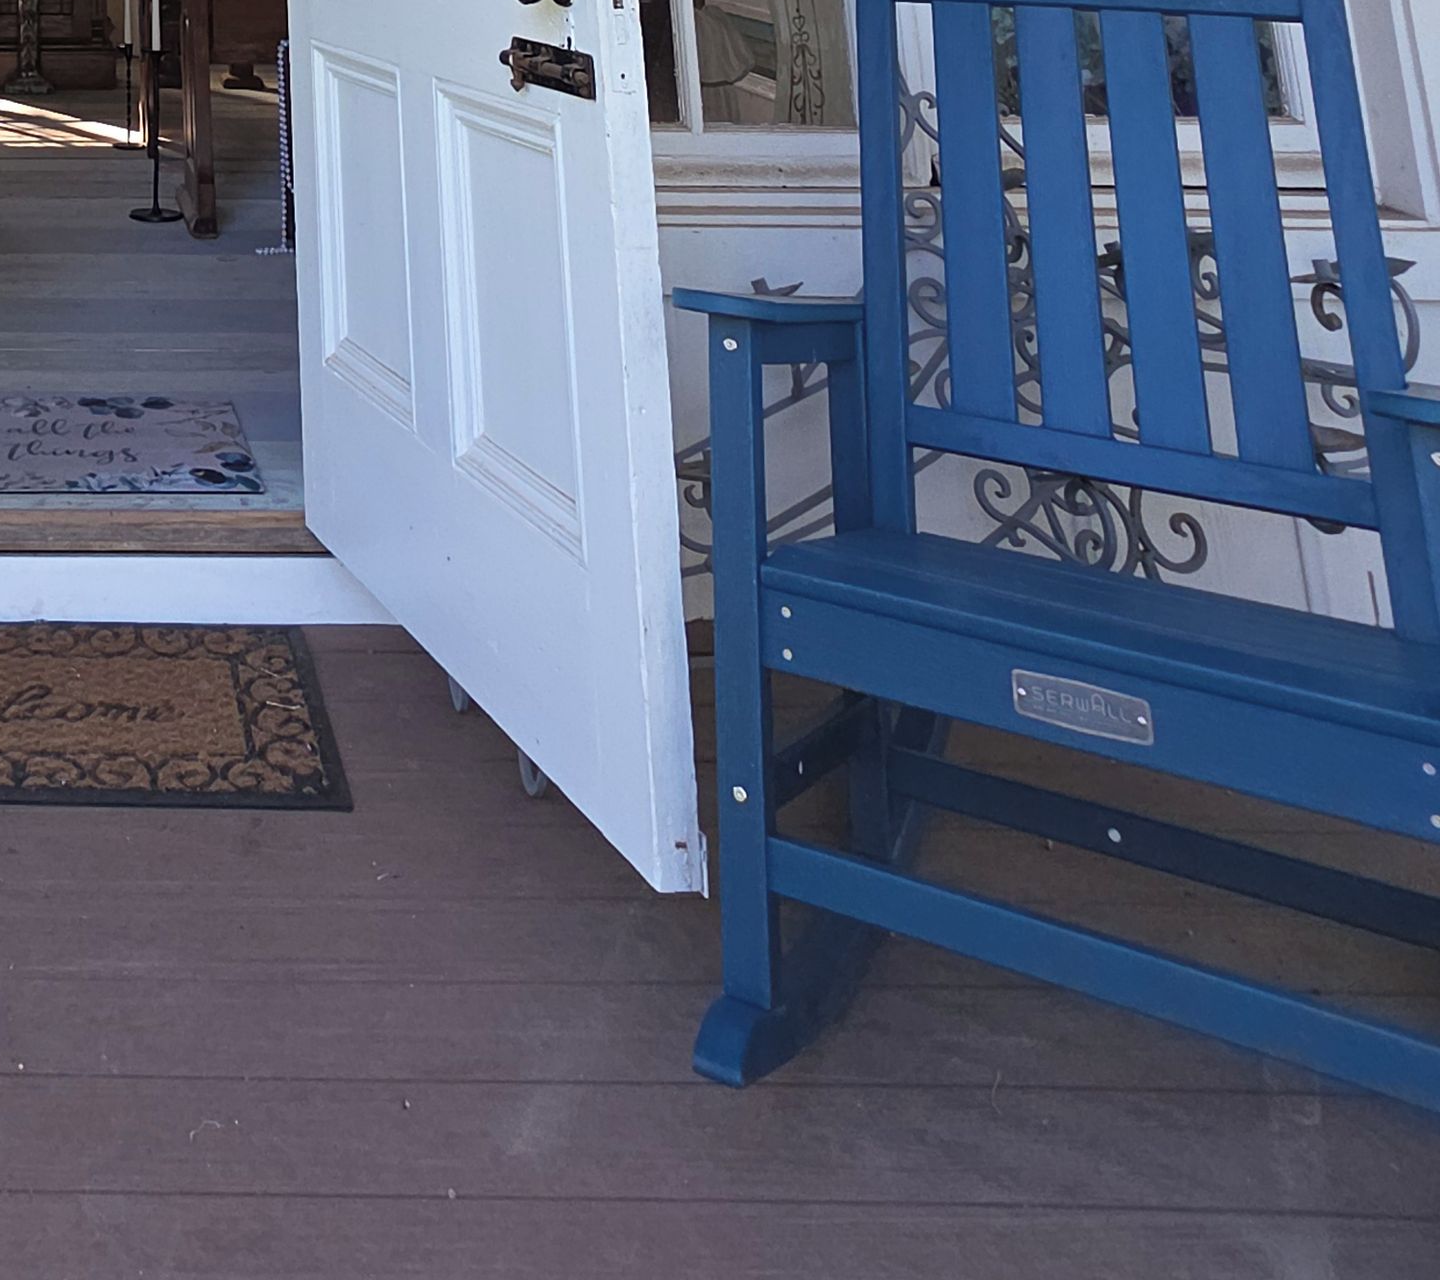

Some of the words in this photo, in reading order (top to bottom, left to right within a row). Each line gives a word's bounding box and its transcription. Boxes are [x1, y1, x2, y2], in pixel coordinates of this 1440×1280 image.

[7, 418, 70, 436] all
[76, 420, 136, 440] the
[6, 440, 139, 464] things
[1031, 685, 1132, 725] SERWALL
